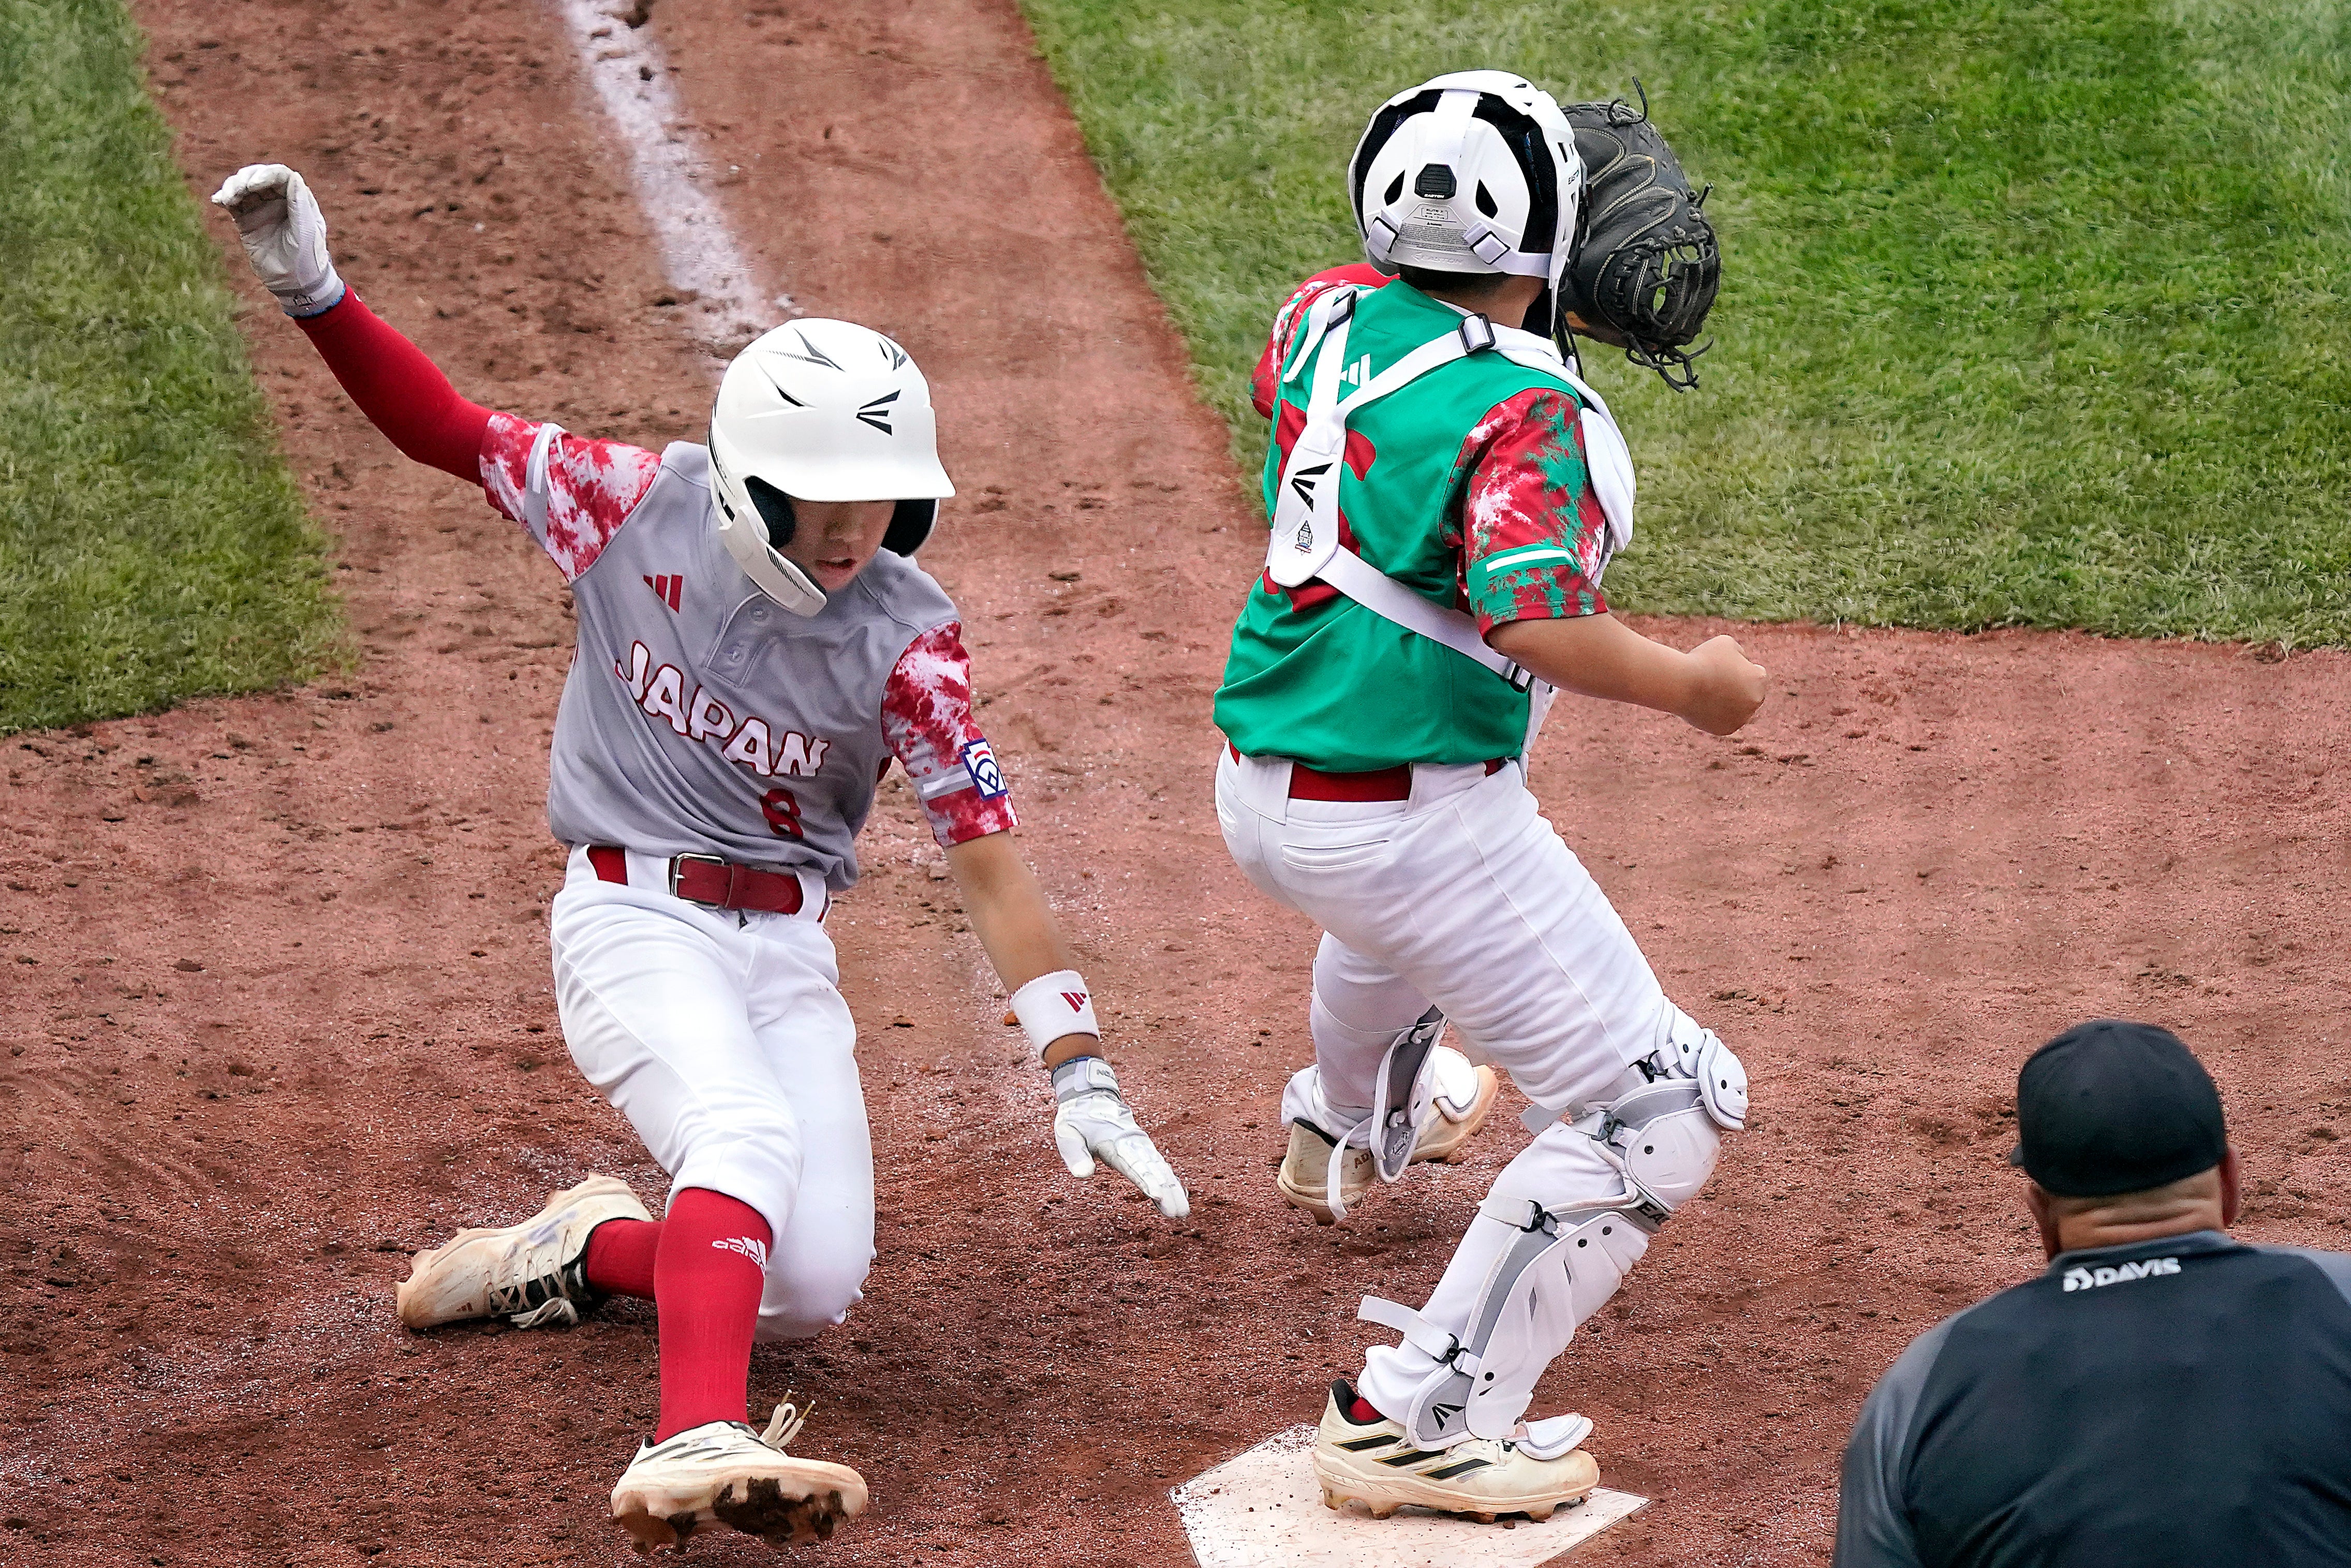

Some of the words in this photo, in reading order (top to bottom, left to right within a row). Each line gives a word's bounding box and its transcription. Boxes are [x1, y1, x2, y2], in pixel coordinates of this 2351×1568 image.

[614, 640, 830, 777] JAPAN
[759, 788, 803, 839] 8
[2093, 1257, 2182, 1287] DAVIS
